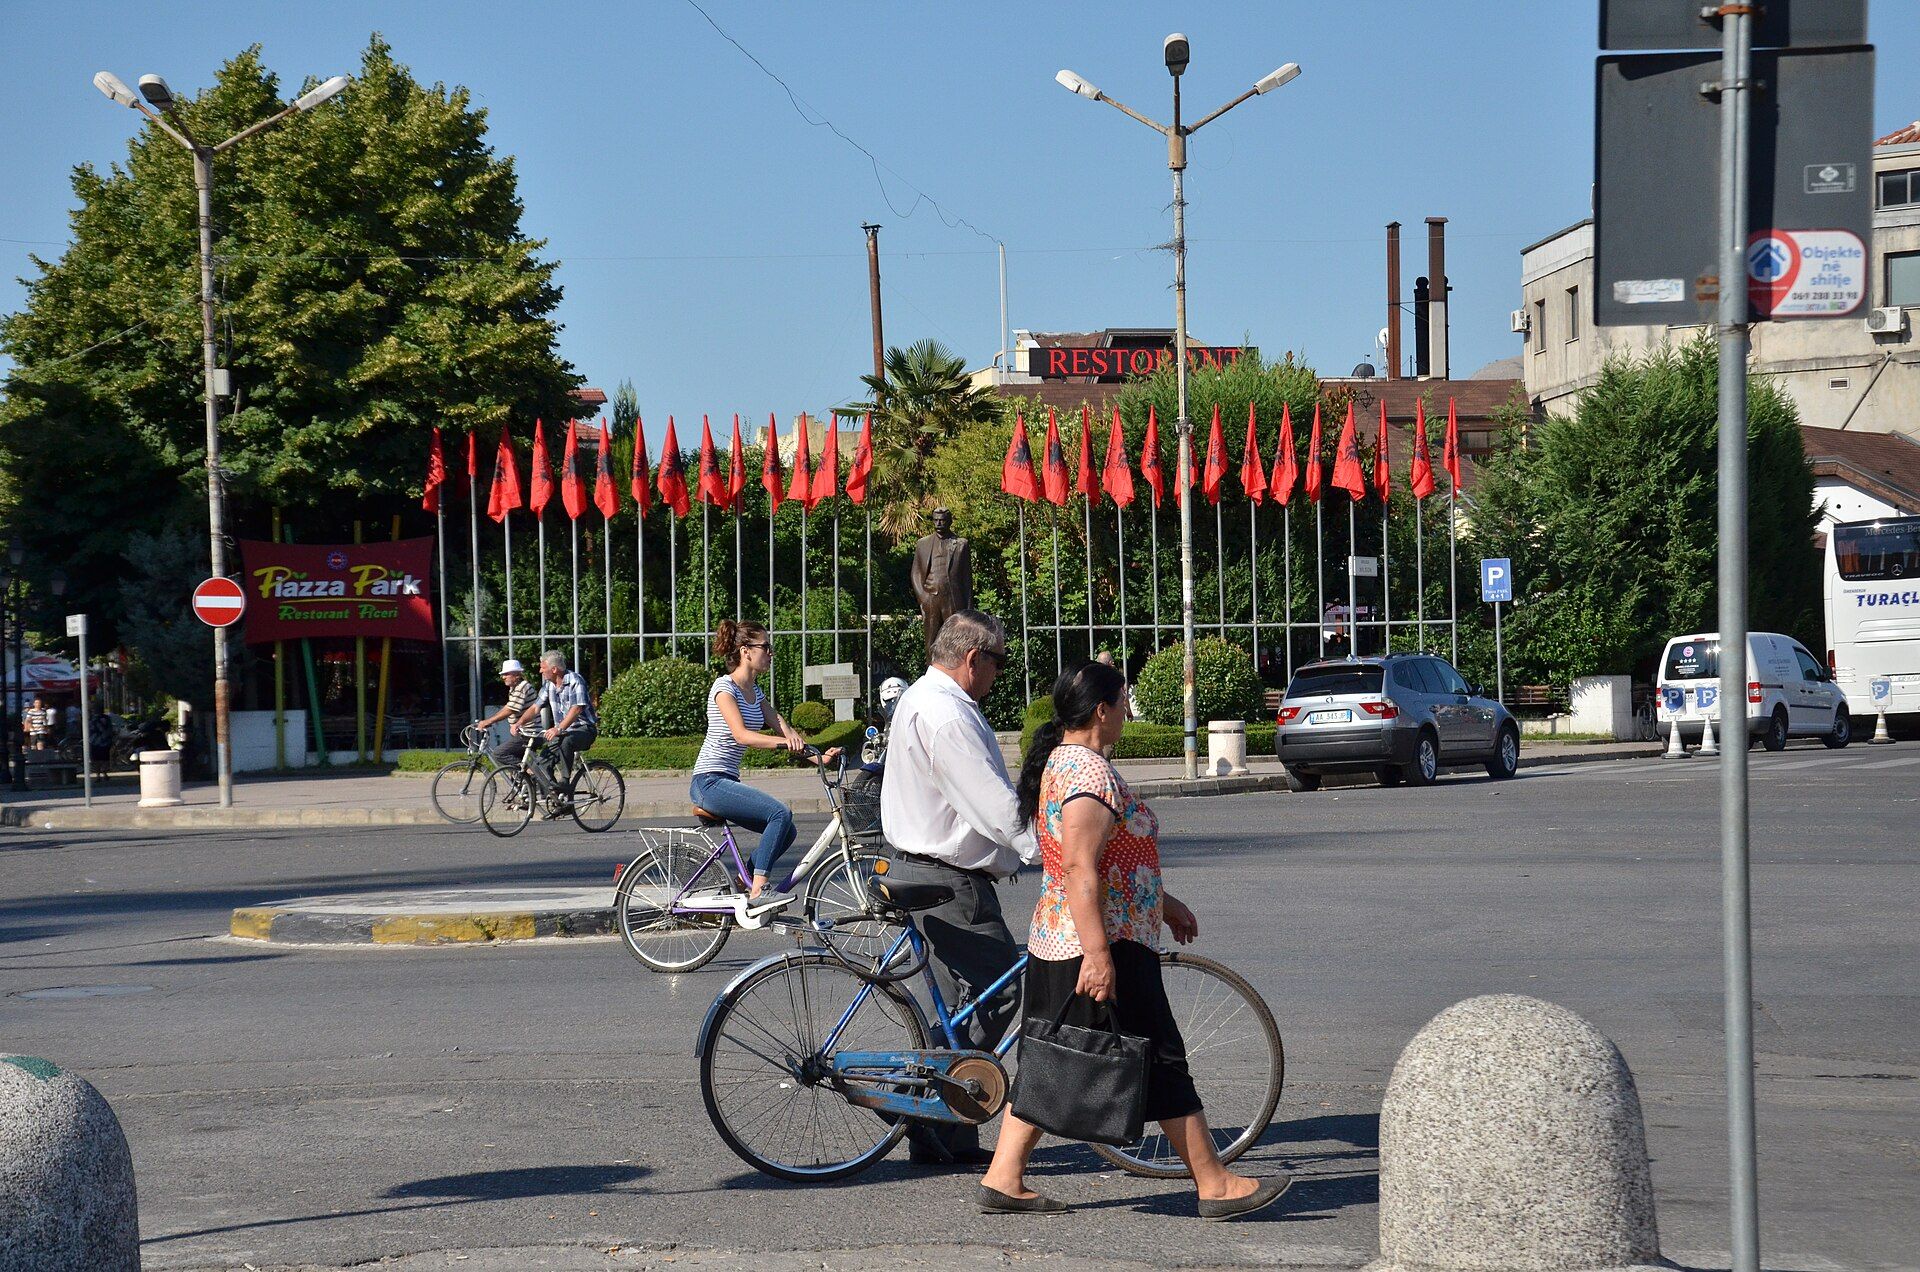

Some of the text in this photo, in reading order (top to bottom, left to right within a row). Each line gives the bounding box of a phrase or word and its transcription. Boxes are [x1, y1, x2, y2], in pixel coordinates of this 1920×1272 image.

[1802, 246, 1861, 260] Objekte
[1822, 261, 1841, 272] në
[1810, 272, 1851, 287] shitje
[253, 565, 422, 599] Piazza Park
[1488, 566, 1504, 586] P
[278, 605, 350, 620] Restorant
[1668, 690, 1680, 704] P
[1702, 689, 1714, 704] P
